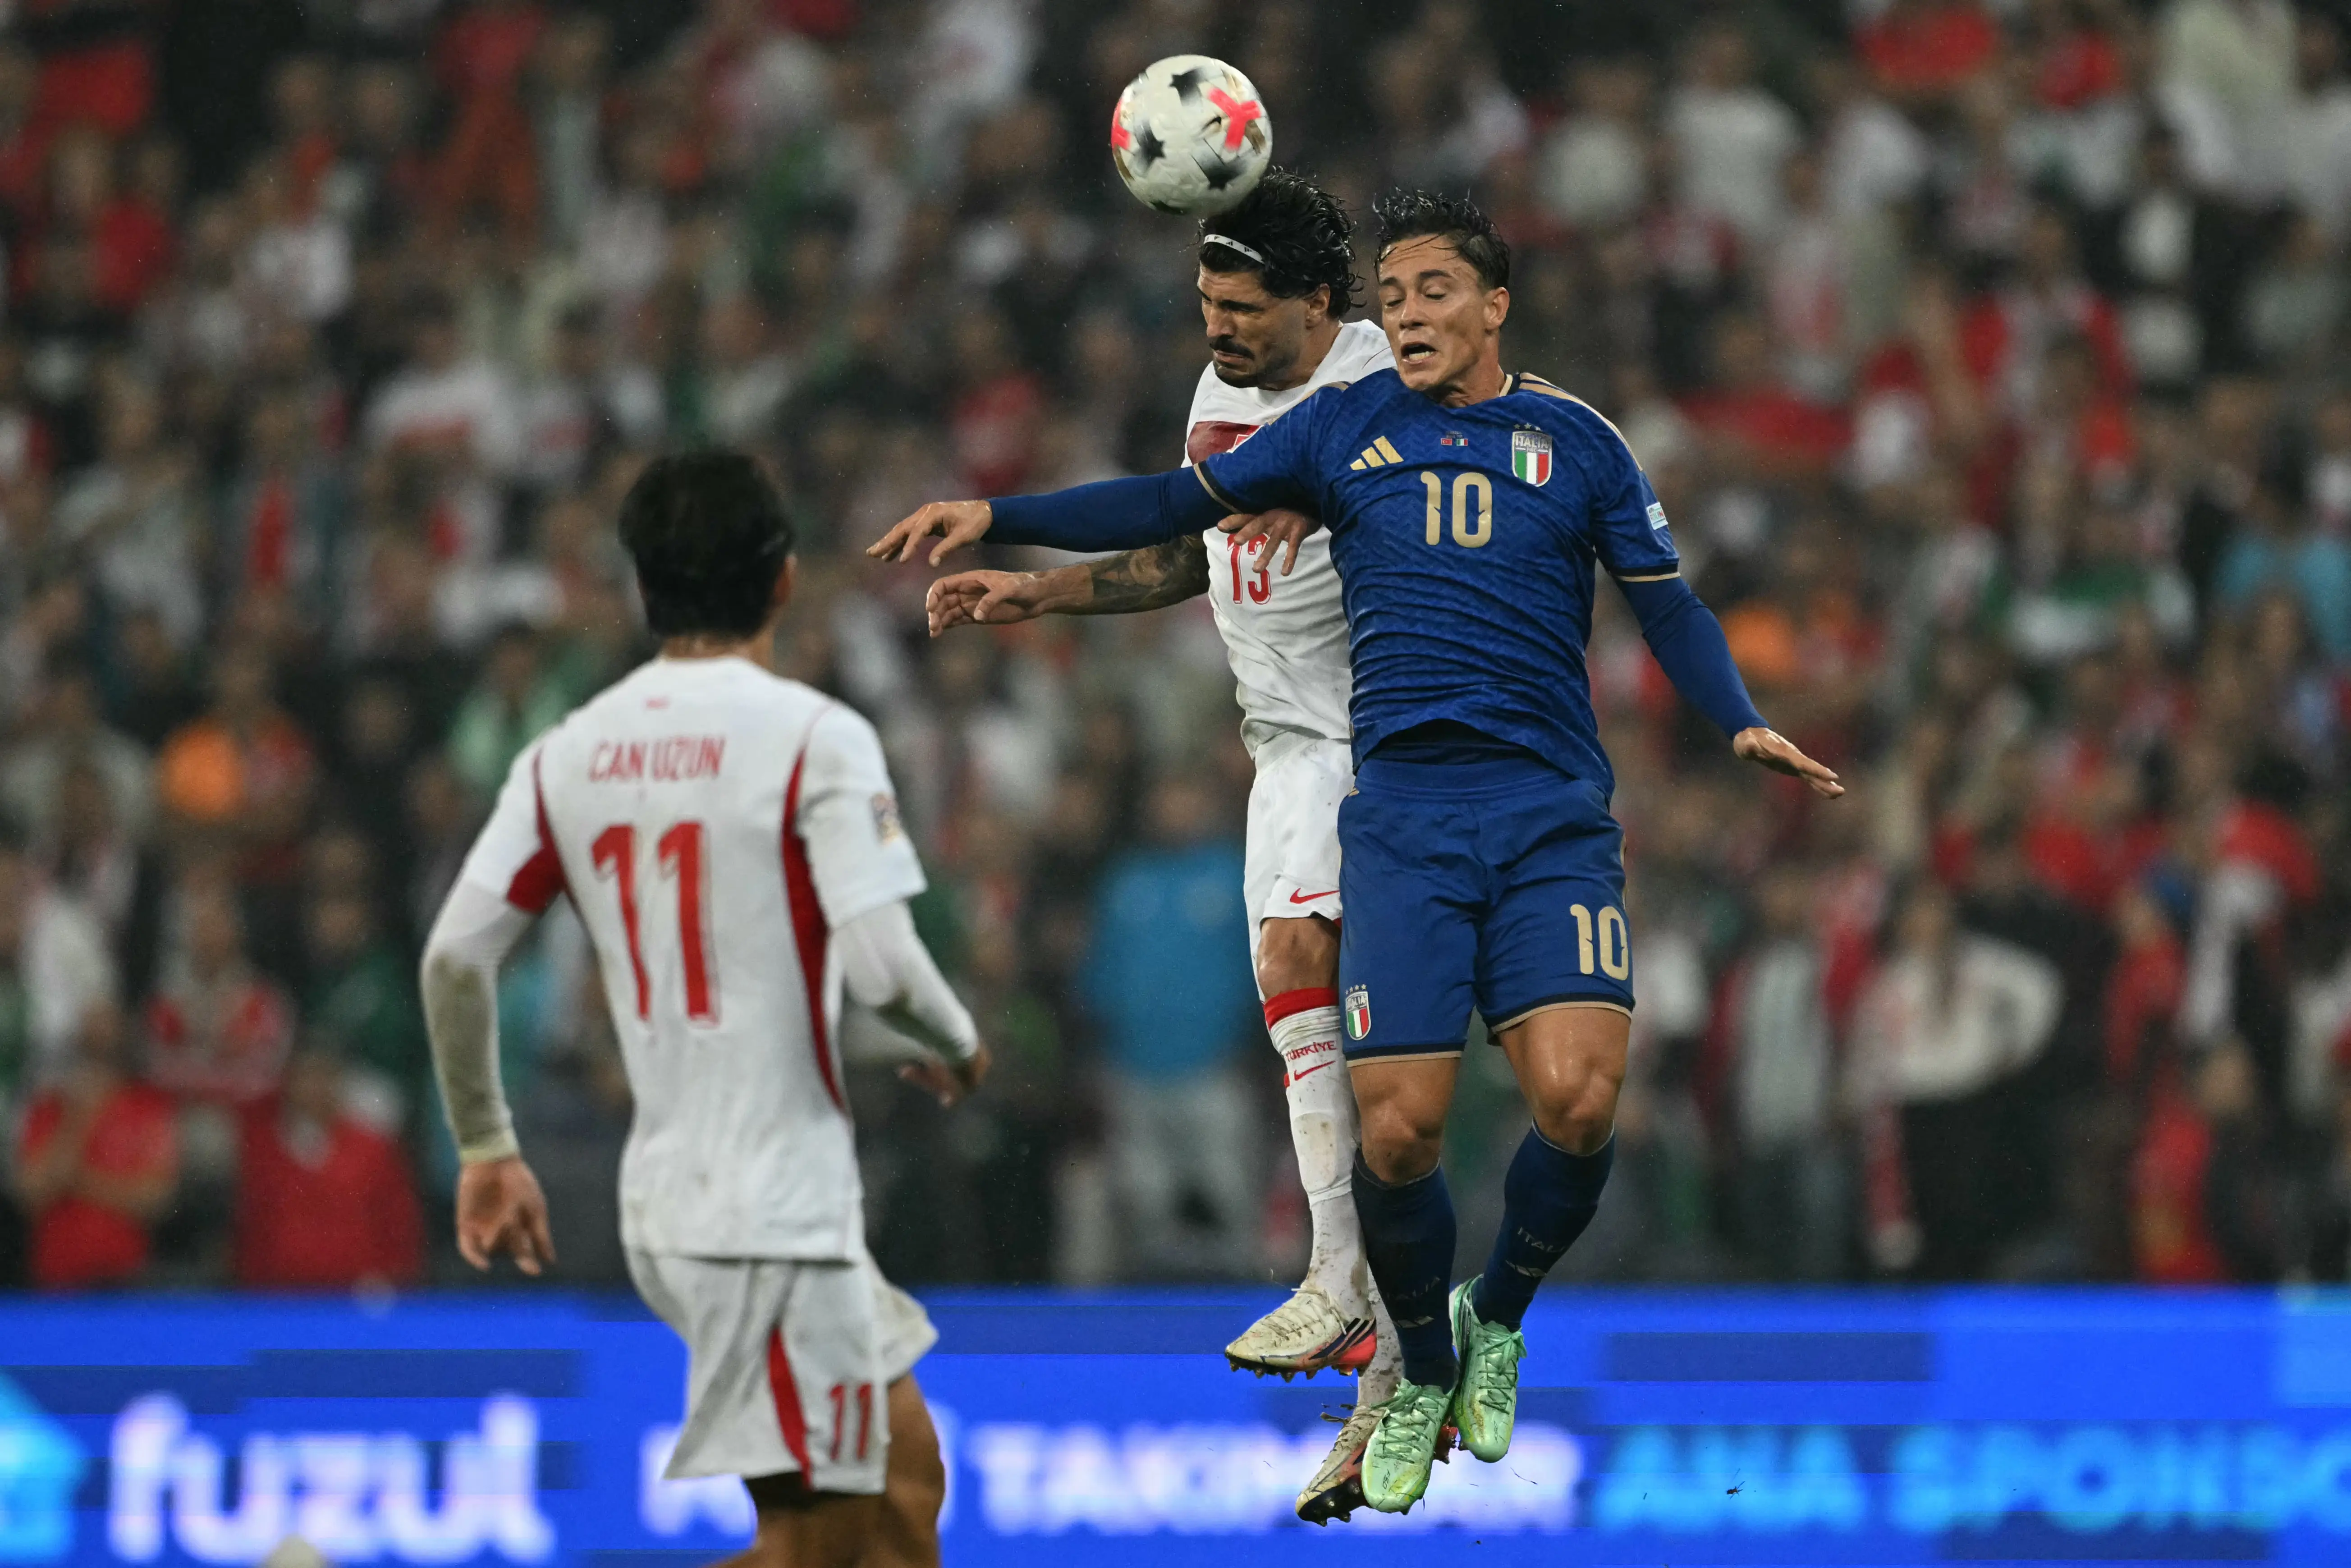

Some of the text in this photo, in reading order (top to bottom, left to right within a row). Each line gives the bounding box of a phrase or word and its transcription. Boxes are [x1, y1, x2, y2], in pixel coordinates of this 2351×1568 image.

[1515, 435, 1548, 449] ITALIA
[1421, 471, 1492, 548] 10
[1227, 532, 1272, 605] 13
[588, 735, 727, 782] CAN UZUN
[591, 821, 718, 1026] 11
[1570, 904, 1629, 981] 10
[1517, 1226, 1566, 1253] ITALI
[829, 1383, 872, 1461] 11
